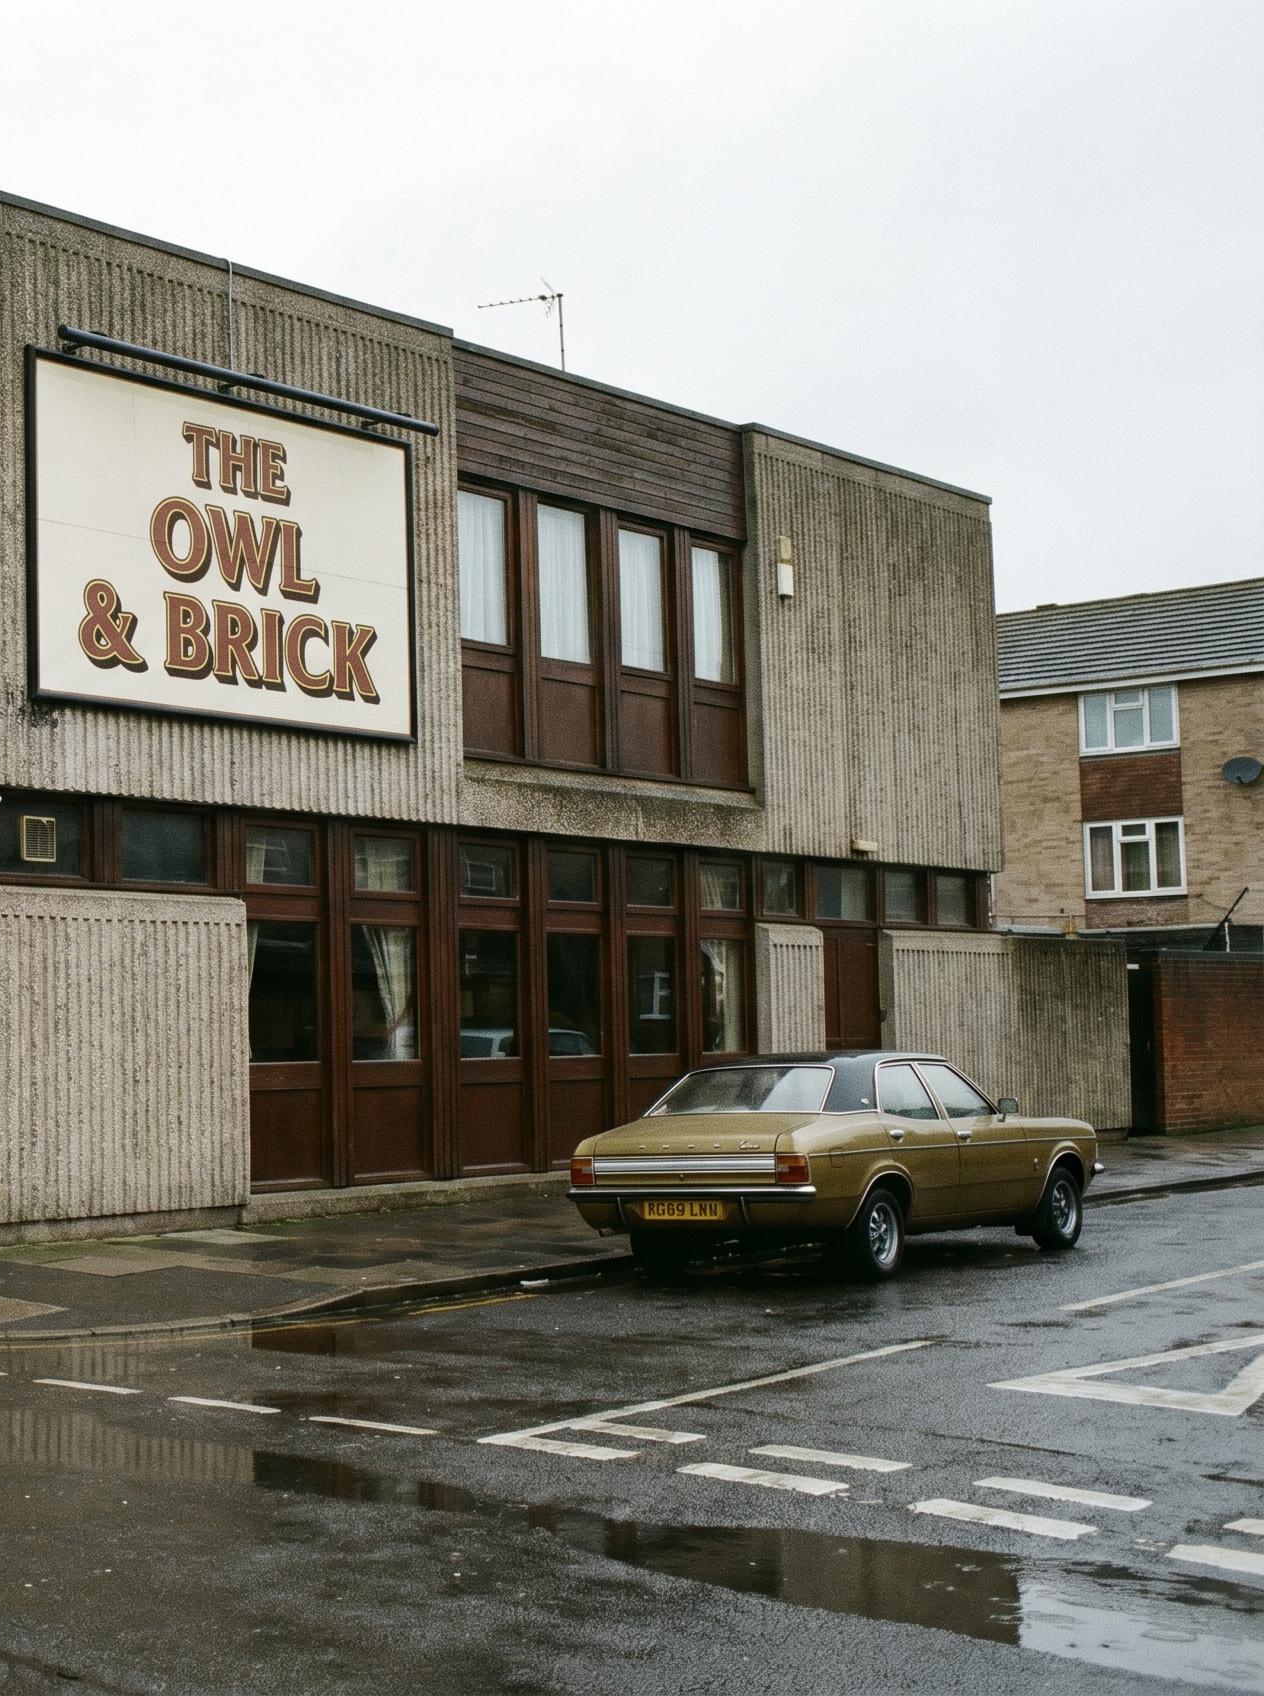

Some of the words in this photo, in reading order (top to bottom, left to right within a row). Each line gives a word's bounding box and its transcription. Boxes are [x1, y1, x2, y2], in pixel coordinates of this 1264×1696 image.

[182, 421, 292, 507] THE
[150, 496, 321, 605] OWL
[78, 578, 149, 673] &
[163, 591, 381, 705] BRICK
